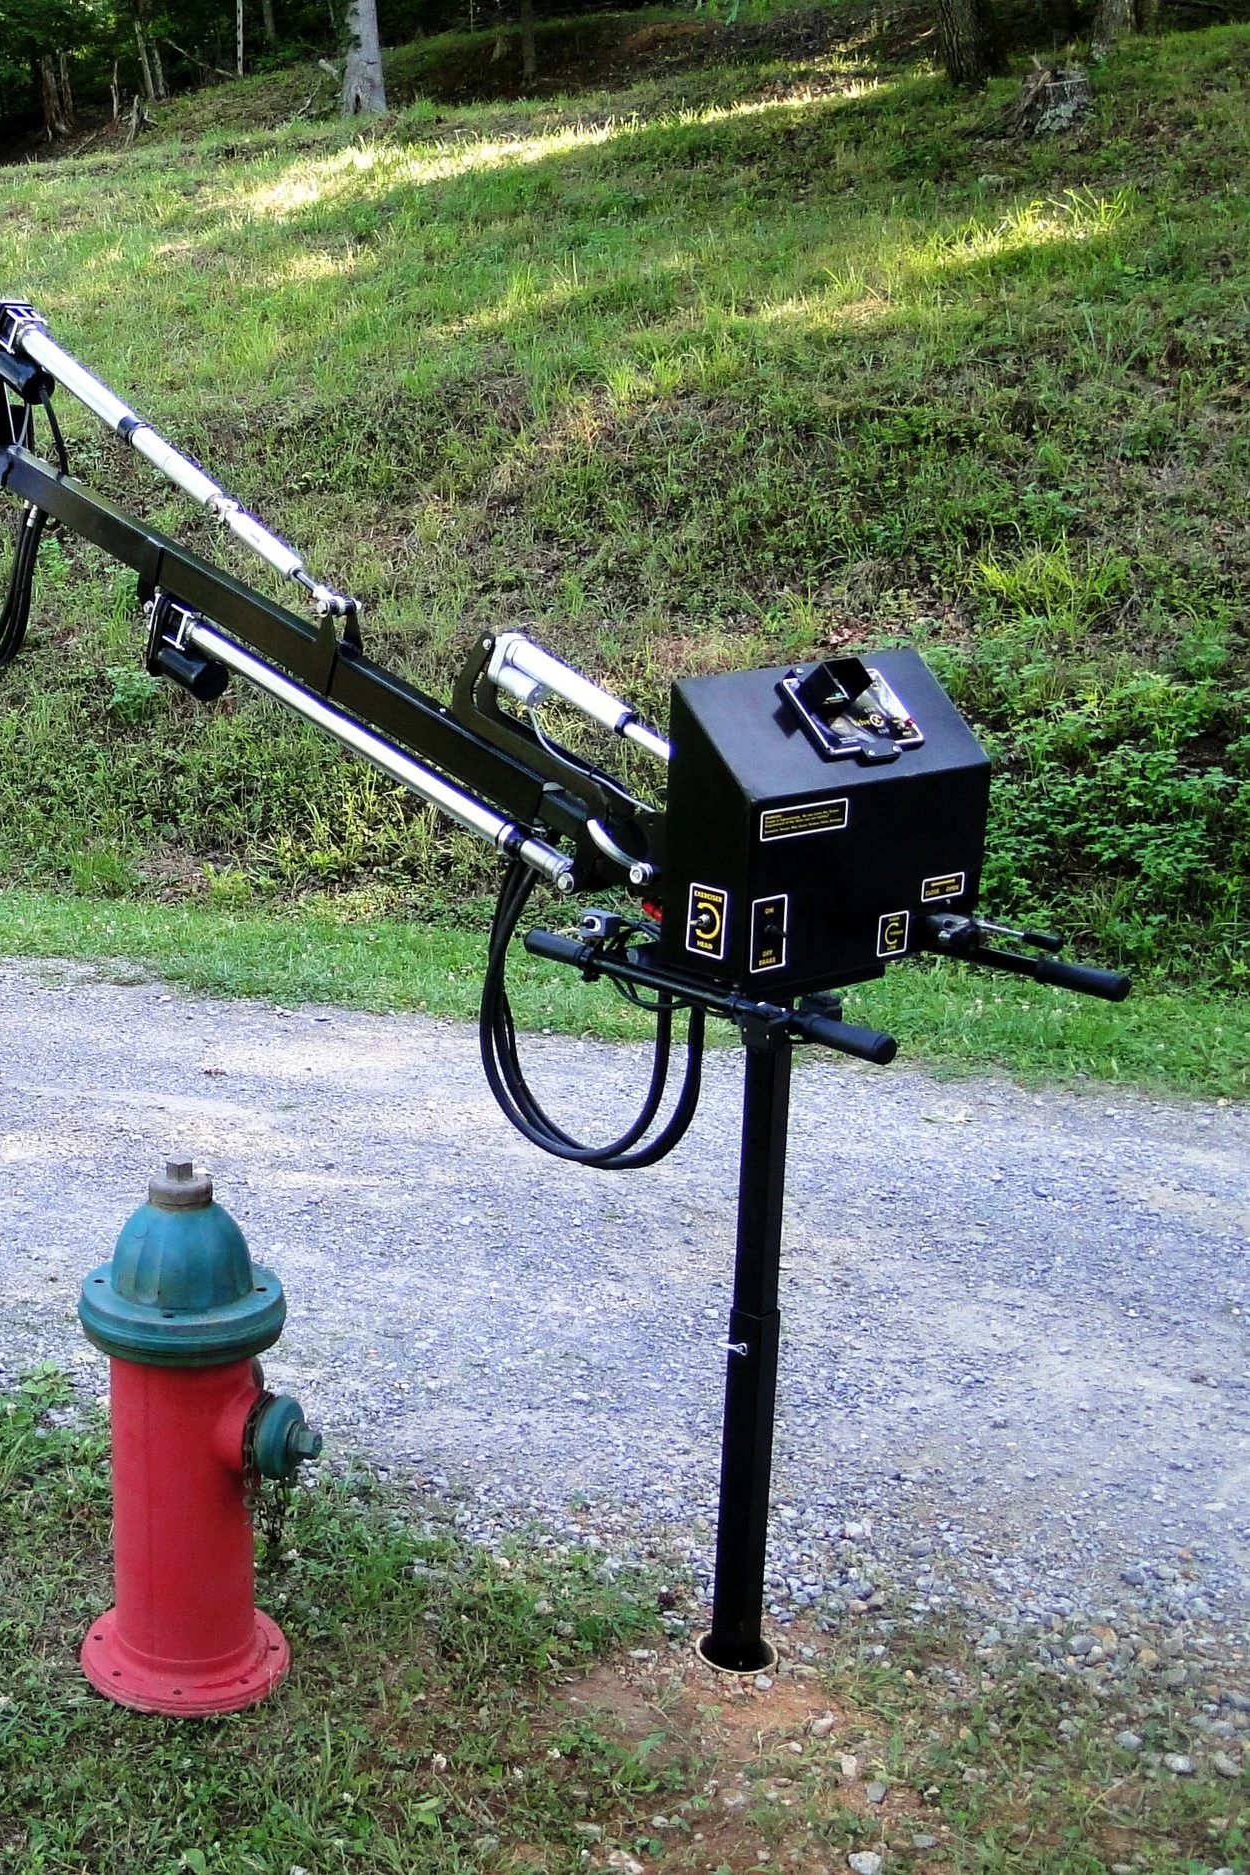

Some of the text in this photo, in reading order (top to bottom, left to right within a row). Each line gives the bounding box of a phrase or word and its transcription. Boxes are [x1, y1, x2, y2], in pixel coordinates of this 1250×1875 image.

[694, 889, 723, 903] EXERCISER
[696, 940, 713, 950] HEAD
[762, 949, 773, 957] OFF
